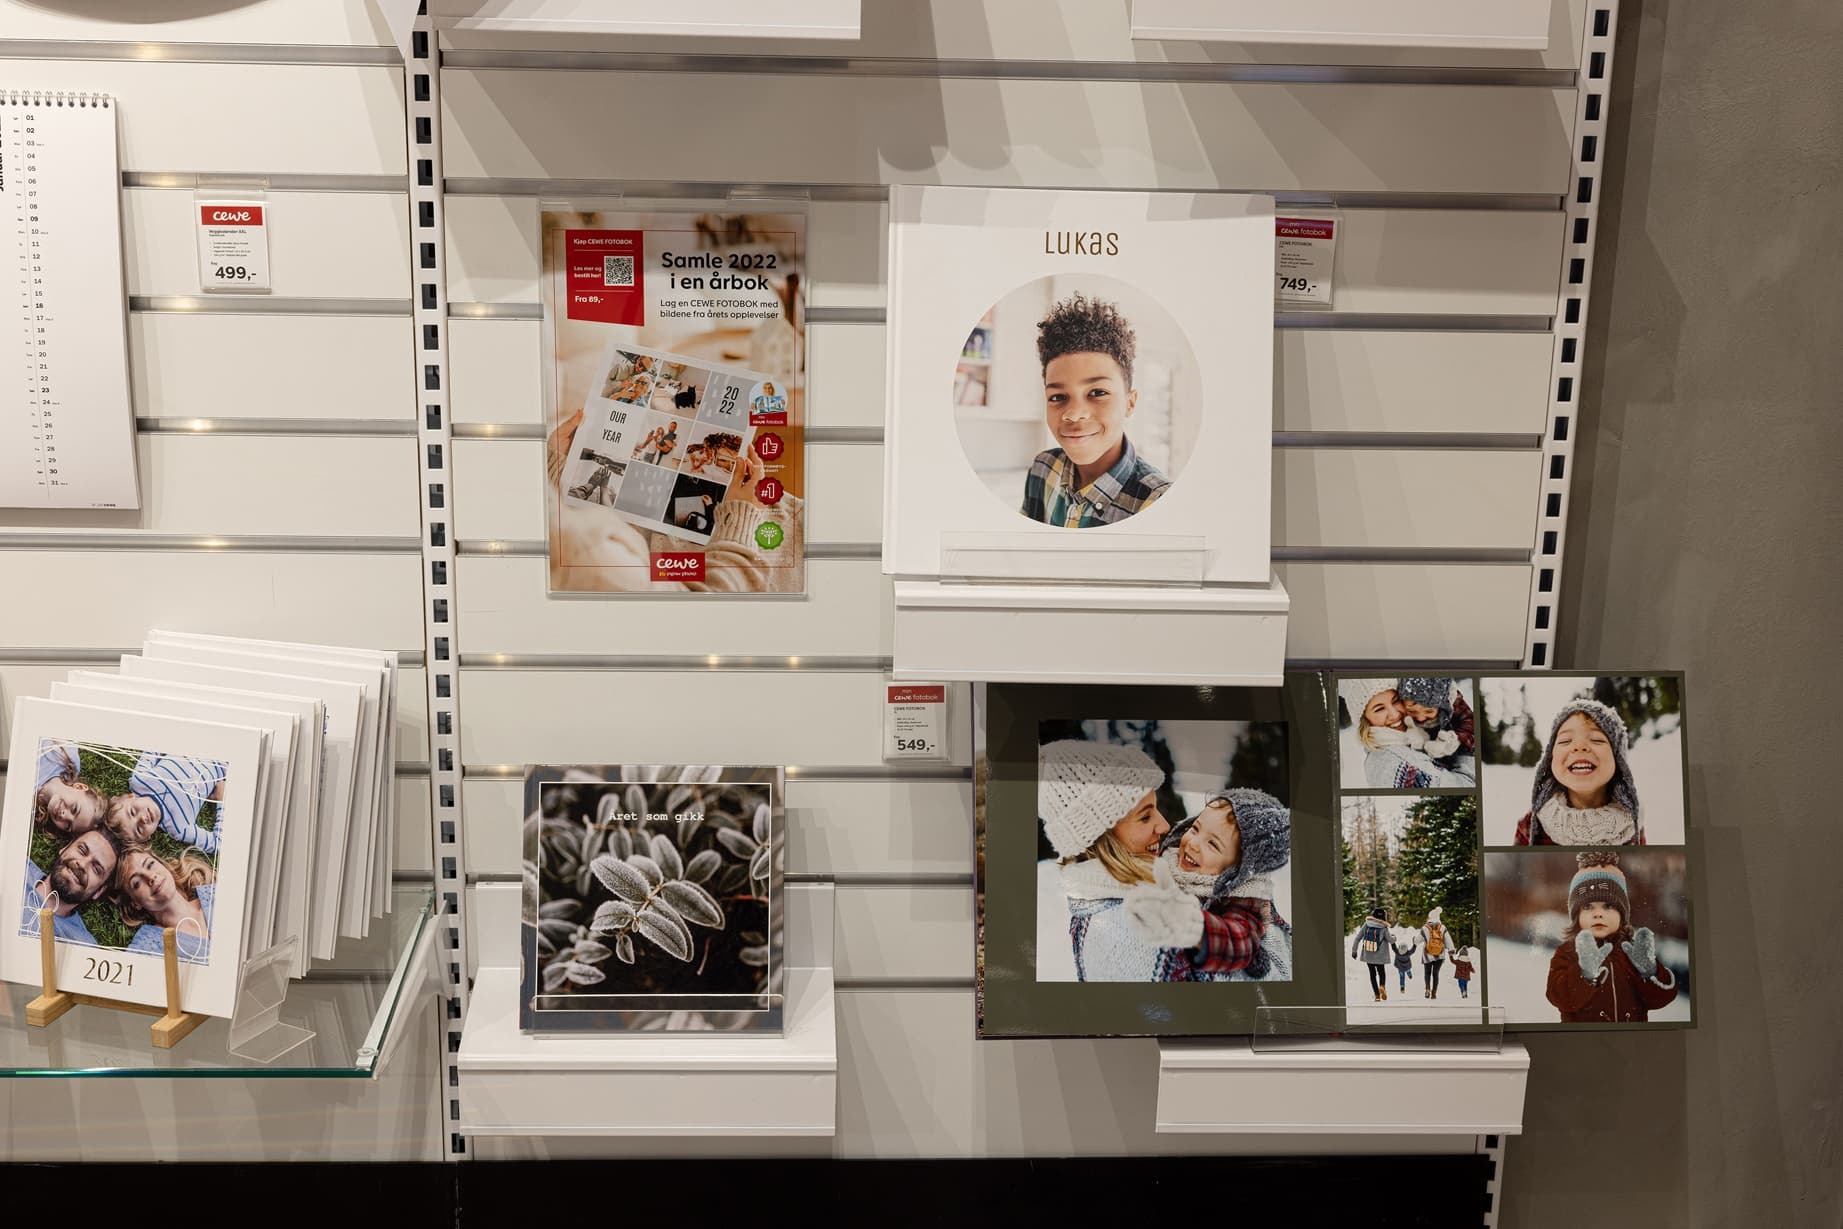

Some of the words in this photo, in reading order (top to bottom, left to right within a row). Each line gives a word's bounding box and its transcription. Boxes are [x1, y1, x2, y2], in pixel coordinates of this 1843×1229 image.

[213, 211, 251, 222] cewe
[661, 252, 723, 269] Samle
[728, 254, 777, 269] 2022
[215, 266, 256, 281] 499,-
[671, 273, 675, 289] i
[681, 276, 704, 289] en
[710, 272, 769, 290] årbok
[1280, 277, 1317, 293] 749,-
[588, 296, 604, 304] 89,-
[660, 299, 677, 310] Lag
[690, 300, 715, 308] CEWE
[717, 300, 758, 308] FOTOBOK
[760, 300, 778, 309] med
[660, 310, 692, 318] bildene
[707, 310, 729, 319] årets
[730, 310, 779, 320] opplevelser
[724, 386, 739, 401] 20
[719, 400, 735, 414] 22
[609, 410, 627, 424] OUR
[602, 428, 622, 444] YEAR
[761, 483, 775, 498] #1
[656, 558, 699, 569] cewe
[897, 739, 935, 753] 549,-
[645, 813, 669, 821] som
[674, 812, 705, 823] gikk
[83, 957, 133, 986] 2021
